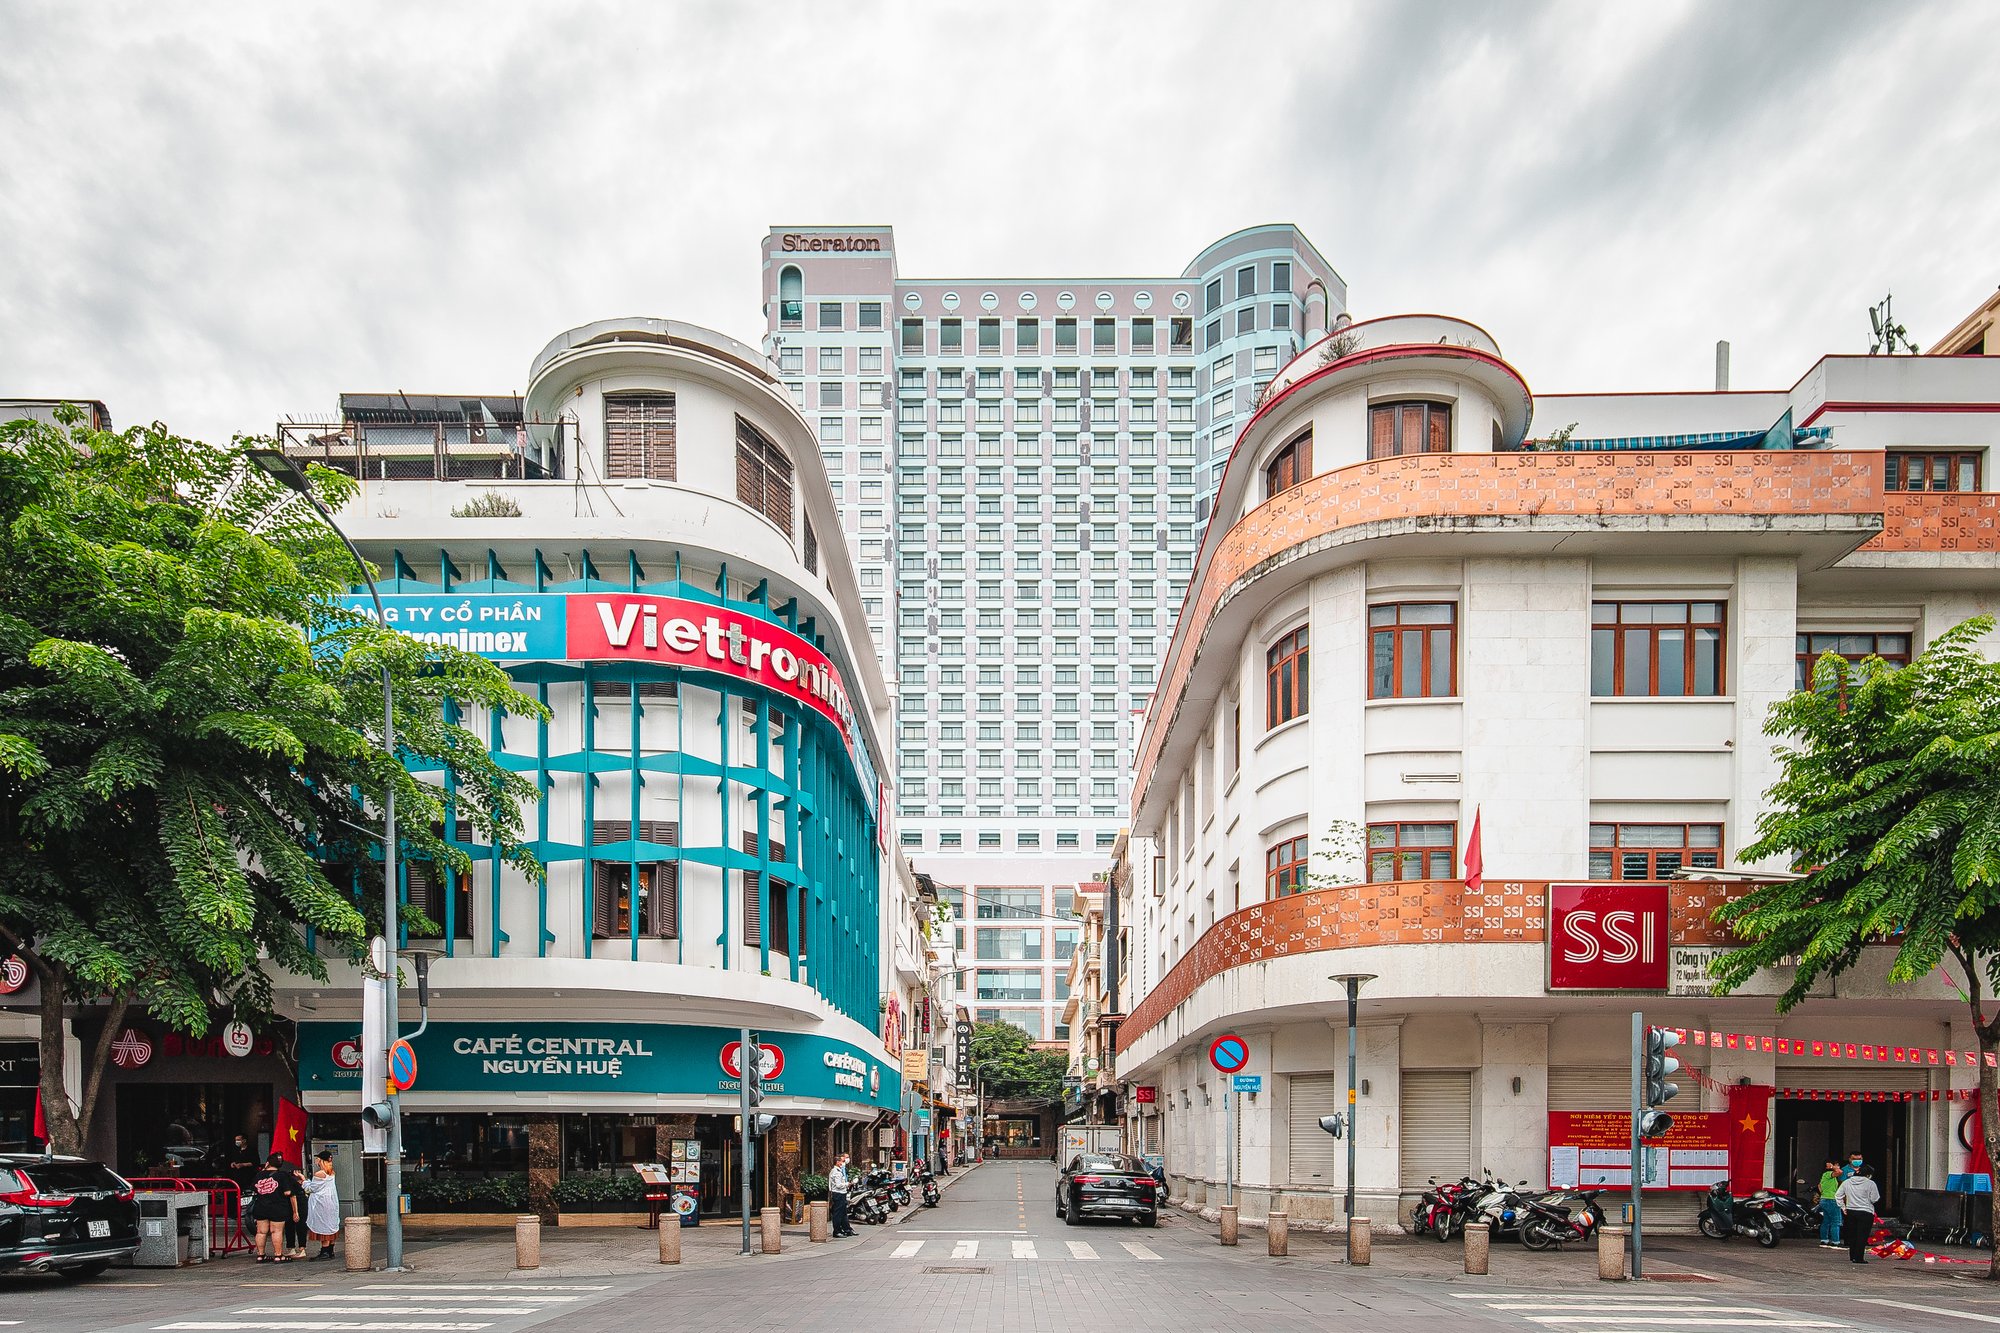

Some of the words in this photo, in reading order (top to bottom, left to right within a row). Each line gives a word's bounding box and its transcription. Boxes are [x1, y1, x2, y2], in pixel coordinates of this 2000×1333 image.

[782, 234, 880, 252] Sheraton
[1401, 458, 1419, 470] SSI
[1519, 456, 1536, 467] SSI
[1556, 456, 1574, 467] SSI
[1597, 456, 1615, 466] SSI
[1636, 456, 1654, 466] SSI
[1674, 456, 1692, 466] SSI
[1715, 455, 1733, 466] SSI
[1753, 455, 1772, 465] SSI
[1833, 454, 1850, 465] SSI
[1556, 478, 1574, 489] SSI
[1361, 486, 1379, 498] SSI
[1616, 488, 1633, 499] SSI
[1772, 488, 1791, 499] SSI
[1321, 495, 1339, 508] SSI
[1342, 500, 1360, 512] SSI
[1556, 500, 1574, 511] SSI
[1906, 496, 1923, 506] SSI
[1942, 496, 1959, 506] SSI
[1887, 506, 1905, 517] SSI
[1941, 517, 1959, 528] SSI
[1271, 526, 1286, 541] SSI
[1887, 527, 1903, 537] SSI
[1922, 527, 1940, 537] SSI
[1866, 537, 1884, 548] SSI
[1941, 537, 1958, 548] SSI
[1977, 538, 1994, 548] SSI
[405, 607, 434, 622] TY
[440, 601, 473, 622] CỔ
[479, 601, 541, 622] PHẦN
[1379, 886, 1399, 897] SSI
[1423, 884, 1443, 895] SSI
[1504, 884, 1523, 895] SSI
[1402, 896, 1422, 907] SSI
[1484, 895, 1503, 906] SSI
[1526, 896, 1544, 906] SSI
[1687, 896, 1706, 908] SSI
[1251, 908, 1262, 918] SSI
[1379, 908, 1398, 919] SSI
[1423, 906, 1443, 917] SSI
[1464, 907, 1483, 917] SSI
[1504, 907, 1523, 917] SSI
[1240, 921, 1250, 932] SSI
[1305, 916, 1320, 928] SSI
[1402, 918, 1422, 929] SSI
[1484, 918, 1502, 928] SSI
[1526, 918, 1544, 928] SSI
[1251, 928, 1262, 939] SSI
[1321, 924, 1339, 936] SSI
[1423, 929, 1442, 939] SSI
[1464, 929, 1483, 939] SSI
[1563, 910, 1655, 964] SSI
[1251, 948, 1262, 959] SSI
[1275, 943, 1287, 954] SSI
[1676, 951, 1699, 968] Công
[1700, 952, 1709, 969] ty
[1676, 970, 1682, 980] 72
[453, 1033, 523, 1055] CAFÉ
[527, 1037, 653, 1056] CENTRAL
[959, 1036, 967, 1082] ANPHA
[483, 1056, 572, 1074] NGUYỄN
[576, 1057, 623, 1079] HUỆ
[764, 1083, 785, 1092] HUE
[1138, 1090, 1154, 1100] SSI
[1603, 1112, 1617, 1120] YẾT
[93, 1221, 105, 1229] 51H
